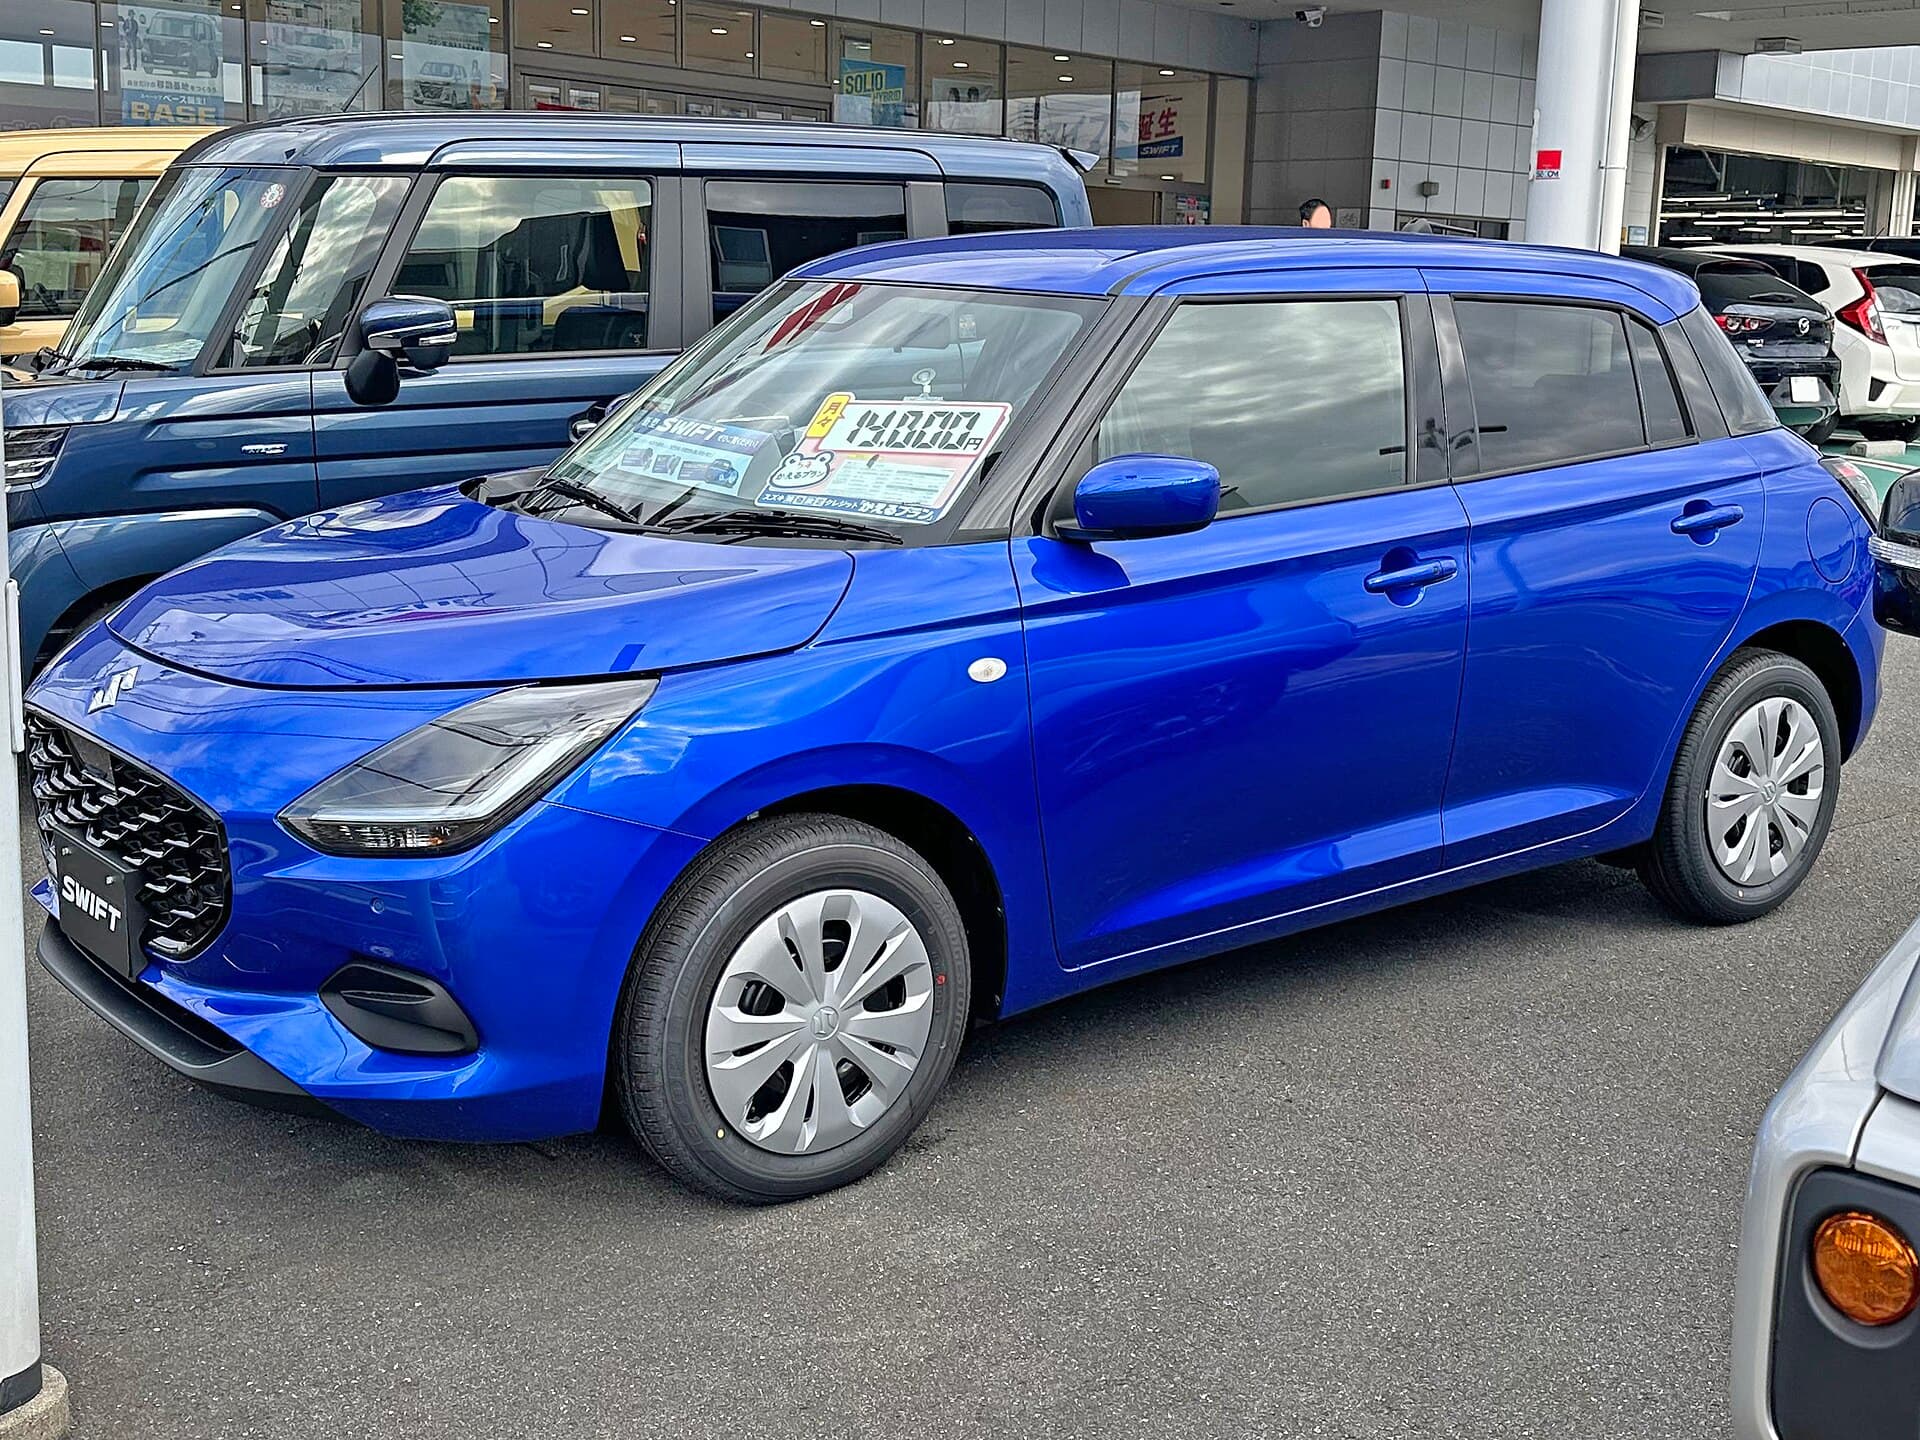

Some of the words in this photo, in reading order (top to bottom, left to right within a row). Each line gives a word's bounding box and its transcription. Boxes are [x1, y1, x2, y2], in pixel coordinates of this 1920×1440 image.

[845, 72, 883, 94] SOLIO
[873, 89, 901, 102] HYBRID
[130, 101, 217, 125] BASE
[1140, 144, 1179, 155] SWIFT
[817, 402, 842, 428] 月々
[656, 417, 726, 441] SWIFT
[776, 470, 825, 481] かえるプラン
[61, 875, 122, 933] SWIFT
